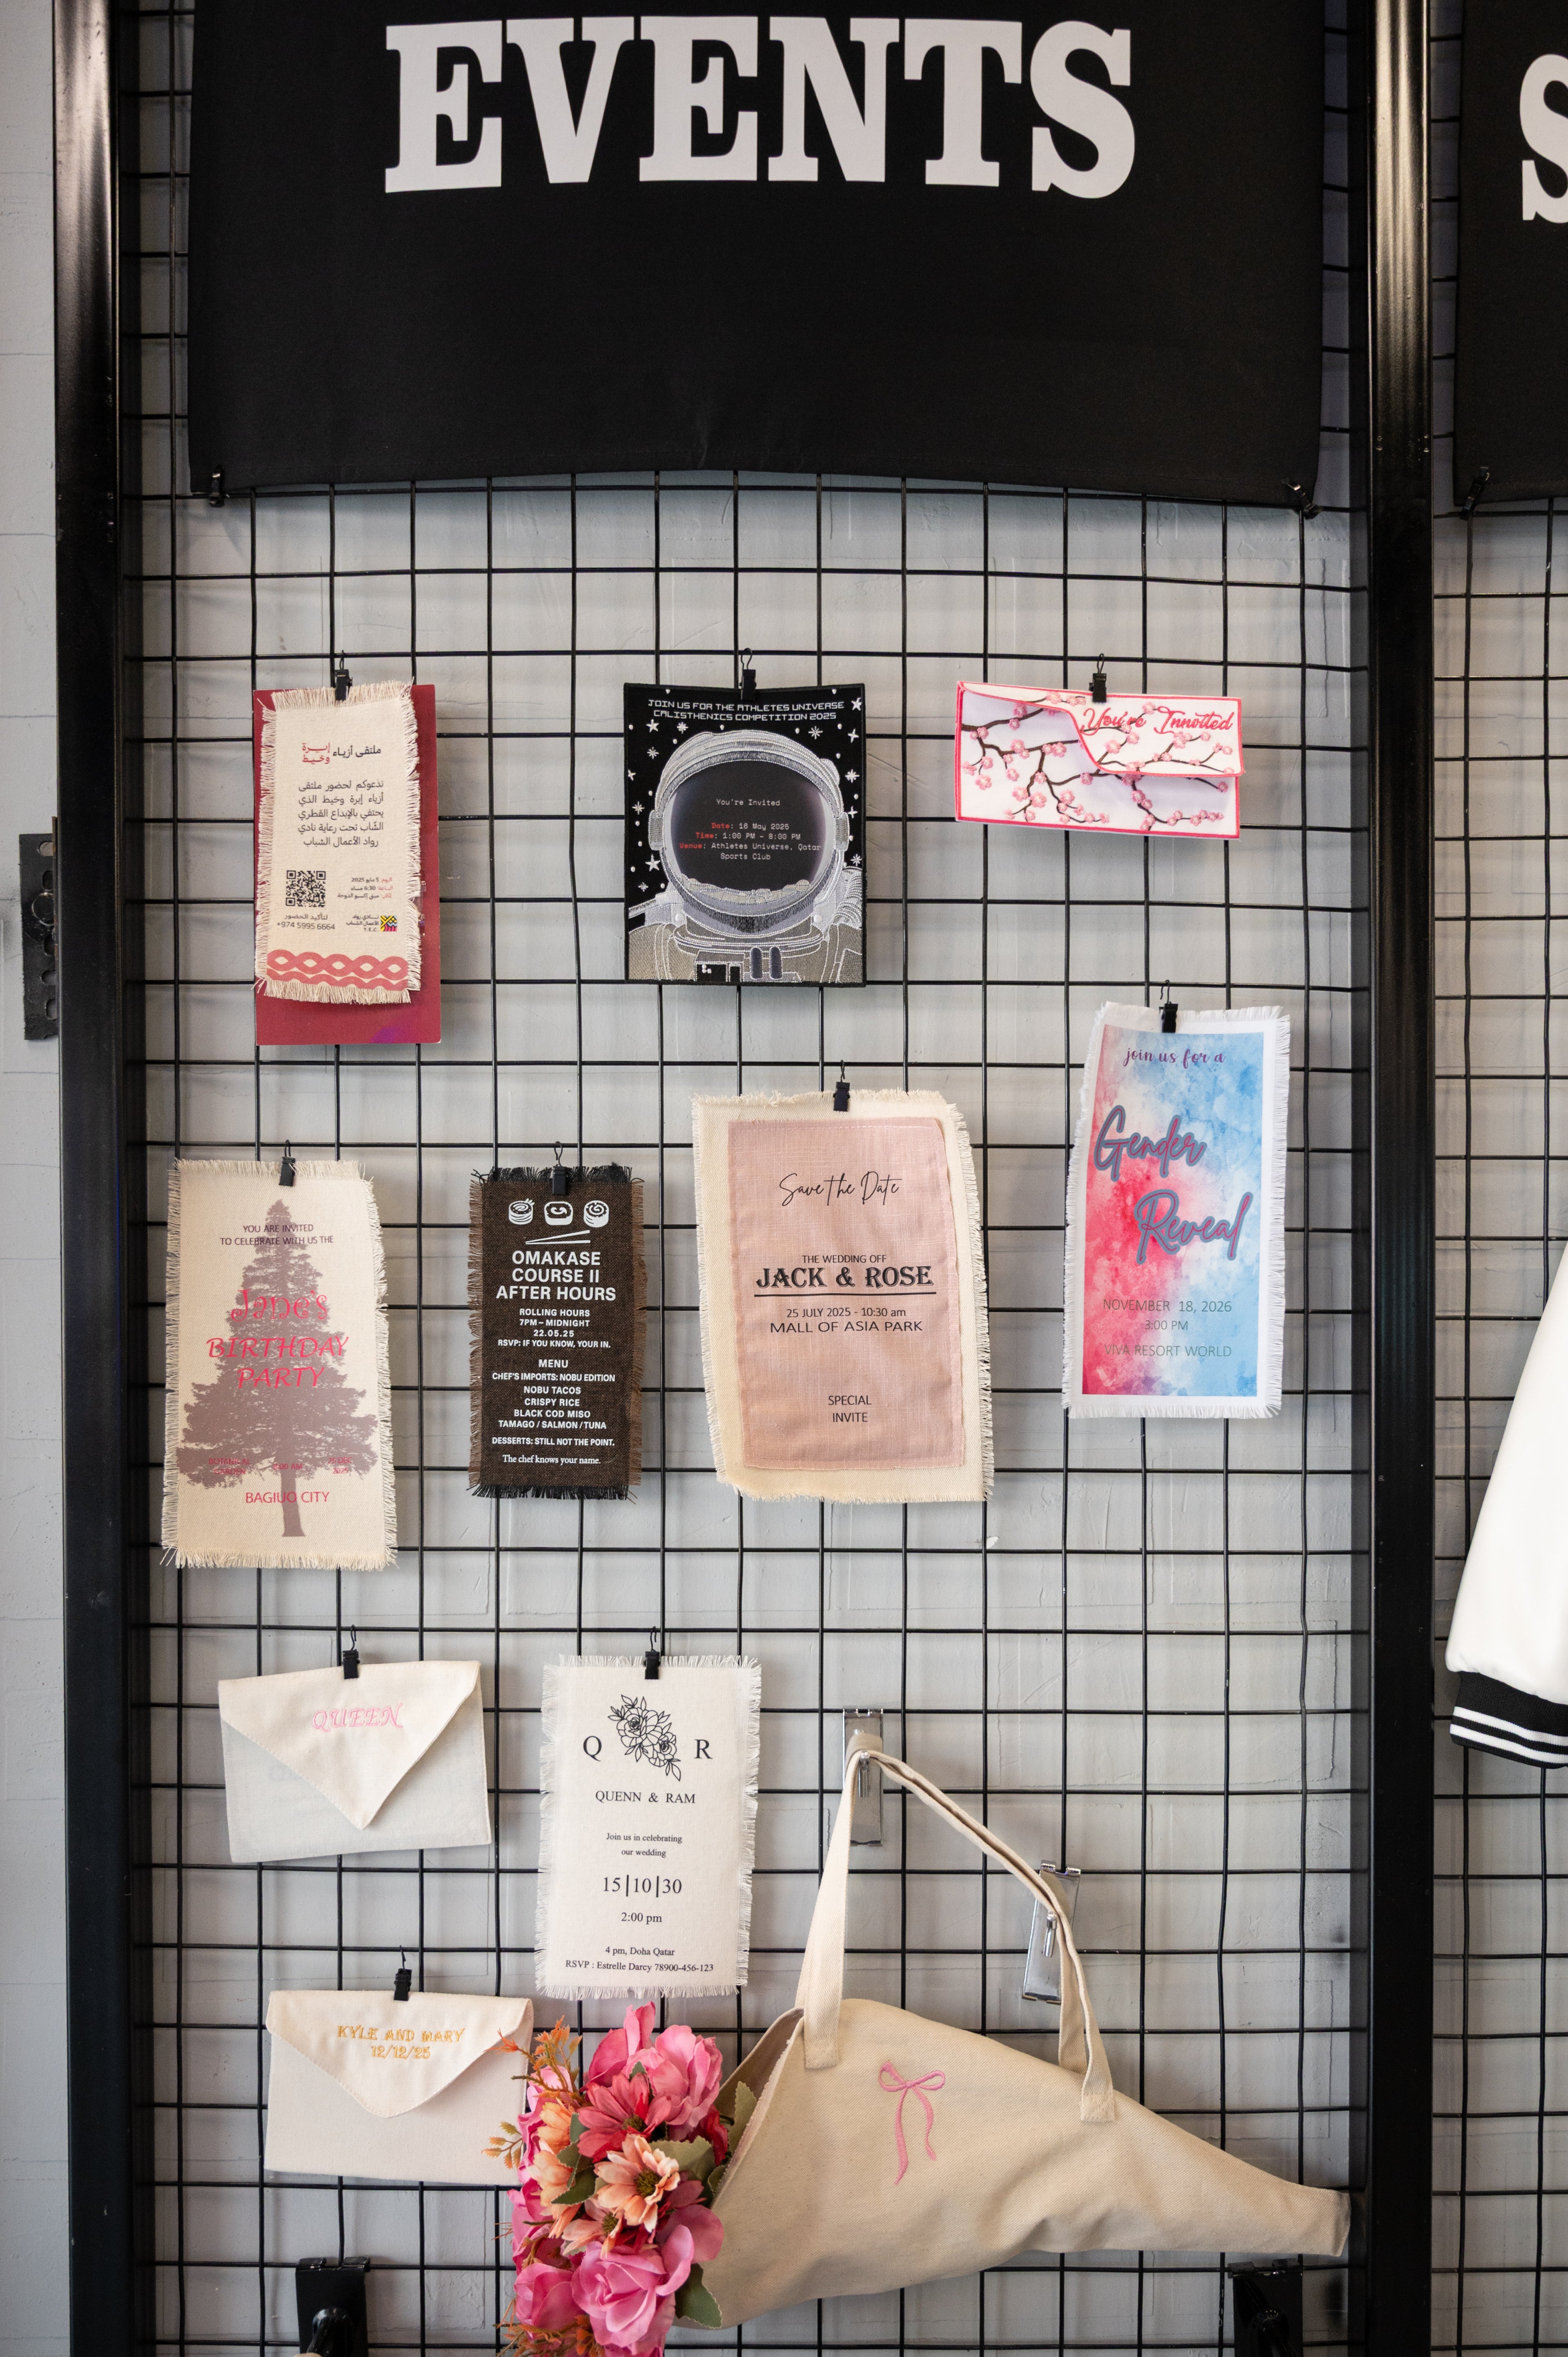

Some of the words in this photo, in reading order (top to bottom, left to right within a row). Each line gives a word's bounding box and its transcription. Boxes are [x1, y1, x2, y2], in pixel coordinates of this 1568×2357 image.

[385, 16, 1135, 199] EVENTS
[648, 699, 674, 709] JOIN
[675, 701, 691, 709] US
[693, 702, 713, 710] FOR
[715, 702, 735, 711] THE
[737, 703, 789, 711] ATHLETES
[793, 701, 845, 710] UNIVERSE
[654, 710, 733, 720] CALISTHENICS
[735, 713, 807, 721] COMPETITION
[798, 843, 822, 851] Qatar
[1123, 1048, 1155, 1067] join
[1158, 1053, 1178, 1063] us
[1182, 1049, 1210, 1069] for
[1214, 1053, 1226, 1063] a
[1094, 1105, 1207, 1182] Gender
[779, 1173, 824, 1206] Save
[823, 1173, 855, 1206] the
[860, 1171, 903, 1206] Date
[282, 1224, 314, 1232] INVITED
[1134, 1189, 1254, 1264] Reveal
[234, 1237, 281, 1245] CELEBRATE
[282, 1237, 305, 1245] WITH
[512, 1250, 601, 1265] OMAKASE
[802, 1255, 819, 1263] THE
[822, 1255, 866, 1263] WEDDING
[869, 1255, 886, 1263] OFF
[512, 1268, 584, 1283] COURSE
[590, 1269, 599, 1283] II
[756, 1267, 826, 1288] JACK
[835, 1267, 855, 1287] &
[864, 1266, 933, 1288] ROSE
[496, 1285, 551, 1300] AFTER
[557, 1286, 616, 1301] HOURS
[230, 1289, 327, 1322] Jane's
[1103, 1298, 1170, 1312] NOVEMBER
[1178, 1300, 1196, 1314] 18,
[1201, 1301, 1232, 1312] 2026
[519, 1308, 557, 1316] ROLLING
[560, 1309, 590, 1317] HOURS
[786, 1309, 799, 1318] 25
[802, 1308, 823, 1318] JULY
[827, 1307, 851, 1317] 2025
[861, 1307, 888, 1317] 10:30
[770, 1322, 813, 1333] MALL
[818, 1322, 838, 1332] OF
[844, 1321, 880, 1331] ASIA
[884, 1321, 922, 1331] PARK
[1145, 1320, 1168, 1330] 3:00
[1172, 1320, 1189, 1331] PM
[533, 1329, 574, 1338] 22.05.25
[207, 1336, 348, 1359] BIRTHDAY
[1104, 1344, 1130, 1355] VIVA
[1134, 1345, 1180, 1356] RESORT
[1185, 1346, 1232, 1357] WORLD
[539, 1359, 568, 1368] MENU
[237, 1366, 325, 1389] PARTY
[492, 1372, 520, 1380] CHEF'S
[559, 1373, 582, 1381] NOBU
[584, 1374, 615, 1382] EDITION
[523, 1386, 549, 1394] NOBU
[551, 1386, 581, 1394] TACOS
[524, 1398, 557, 1406] CRISPY
[559, 1398, 580, 1407] RICE
[828, 1395, 871, 1406] SPECIAL
[514, 1409, 543, 1417] BLACK
[545, 1409, 565, 1418] COD
[833, 1412, 868, 1423] INVITE
[498, 1420, 535, 1428] TAMAGO
[541, 1420, 578, 1429] SALMON
[535, 1437, 555, 1445] STILL
[502, 1454, 517, 1463] The
[518, 1454, 535, 1463] chef
[535, 1455, 559, 1463] knows
[560, 1458, 578, 1466] your
[245, 1491, 297, 1503] BAGIUO
[301, 1491, 329, 1503] CITY
[313, 1703, 404, 1732] QUEEN
[583, 1735, 602, 1762] Q
[694, 1739, 713, 1759] R
[595, 1791, 641, 1802] QUENN
[648, 1793, 658, 1803] &
[666, 1793, 695, 1804] RAM
[642, 1834, 682, 1844] celebrating
[635, 1849, 666, 1858] wedding
[621, 1912, 644, 1922] 2:00
[646, 1915, 662, 1925] pm
[630, 1947, 651, 1955] Doha
[653, 1948, 675, 1957] Qatar
[566, 1960, 590, 1968] RSVP
[597, 1961, 626, 1970] Estrelle
[628, 1963, 652, 1973] Darcy
[654, 1963, 714, 1972] 78900-456-123
[338, 2025, 378, 2040] KYLE
[384, 2029, 414, 2042] AND
[421, 2028, 465, 2043] MARY
[372, 2045, 430, 2059] 12/12/25
